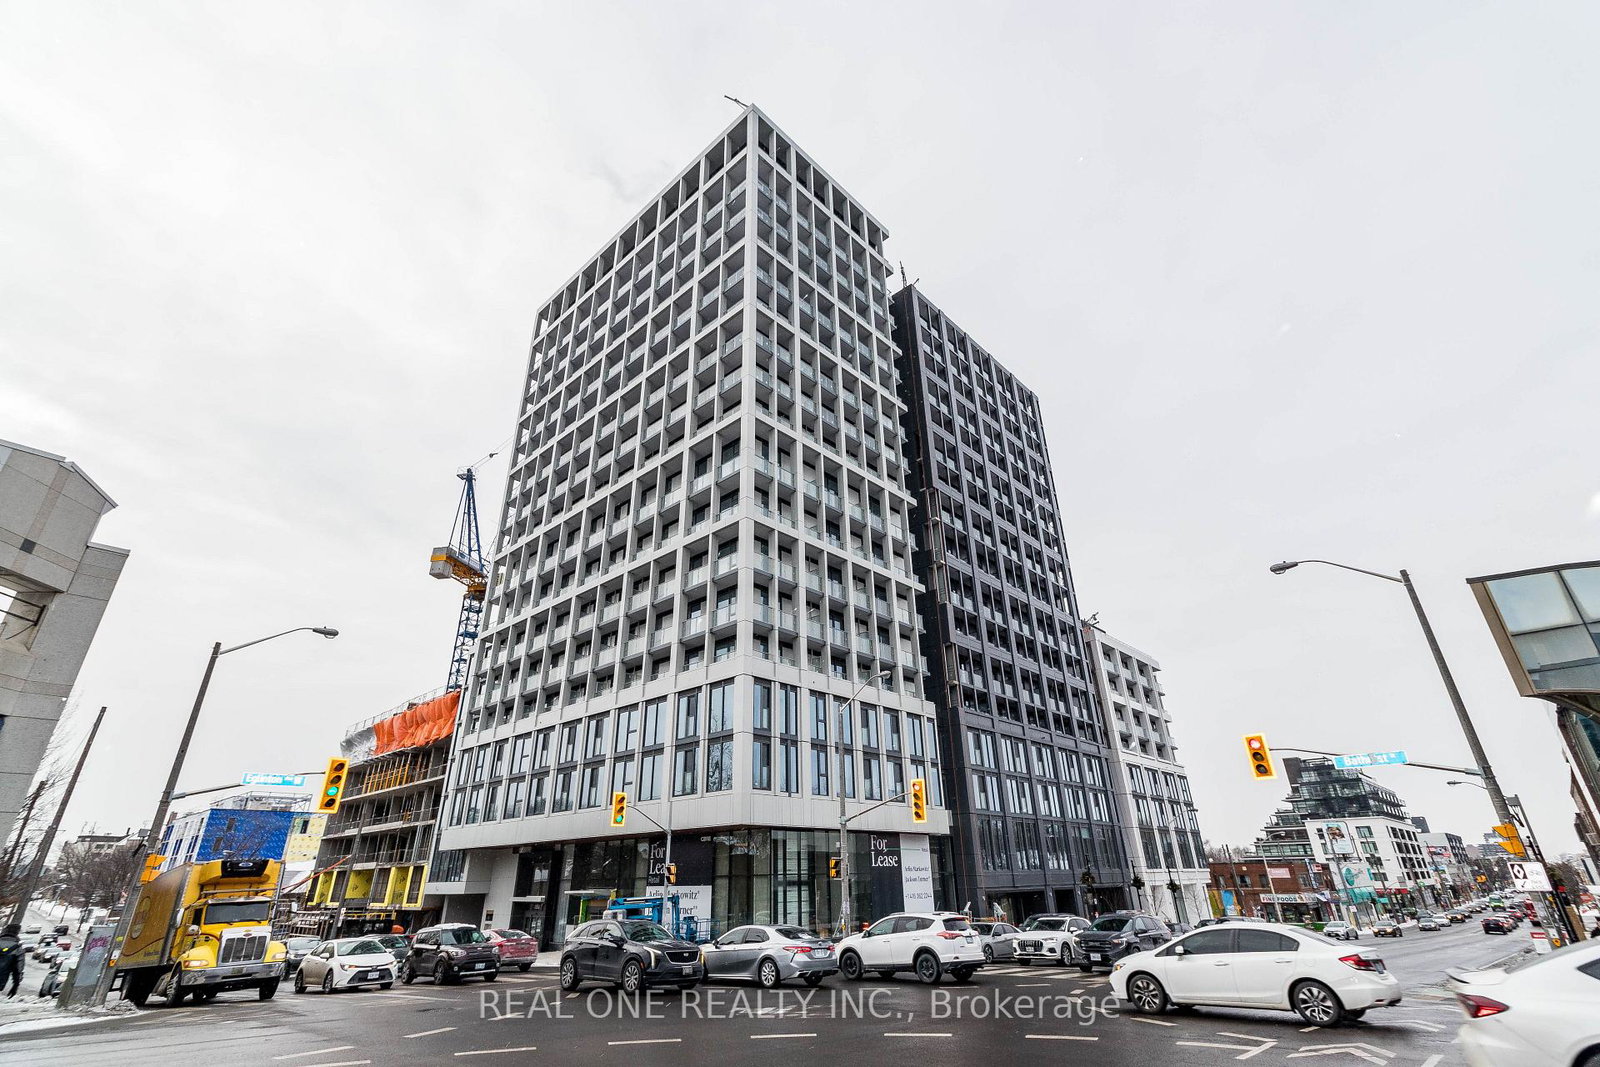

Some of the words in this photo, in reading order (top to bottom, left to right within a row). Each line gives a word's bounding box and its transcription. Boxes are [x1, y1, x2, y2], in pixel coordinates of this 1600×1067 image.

[870, 835, 887, 850] For
[651, 844, 665, 858] For
[871, 851, 898, 867] Lease
[649, 860, 667, 874] Lea
